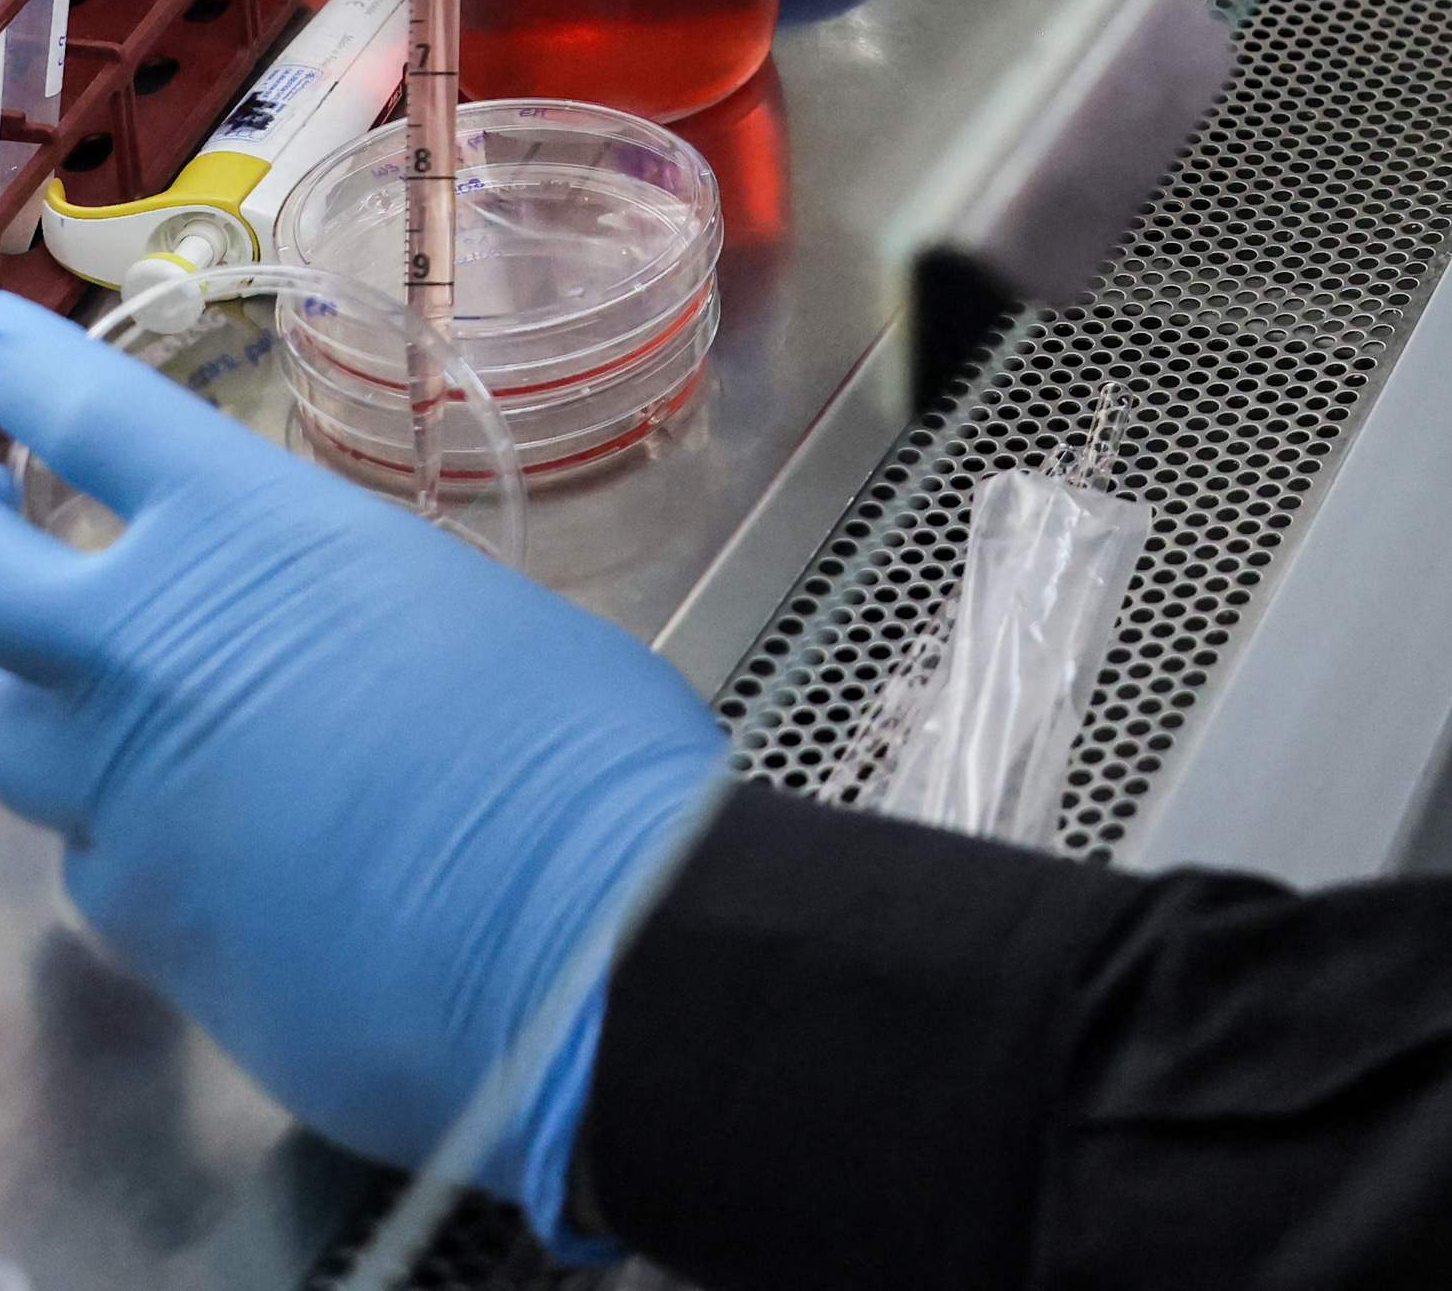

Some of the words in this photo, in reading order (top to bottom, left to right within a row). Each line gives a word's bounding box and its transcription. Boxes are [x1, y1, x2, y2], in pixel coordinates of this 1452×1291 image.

[415, 43, 431, 68] 7
[414, 148, 431, 173] 8
[412, 253, 430, 279] 9
